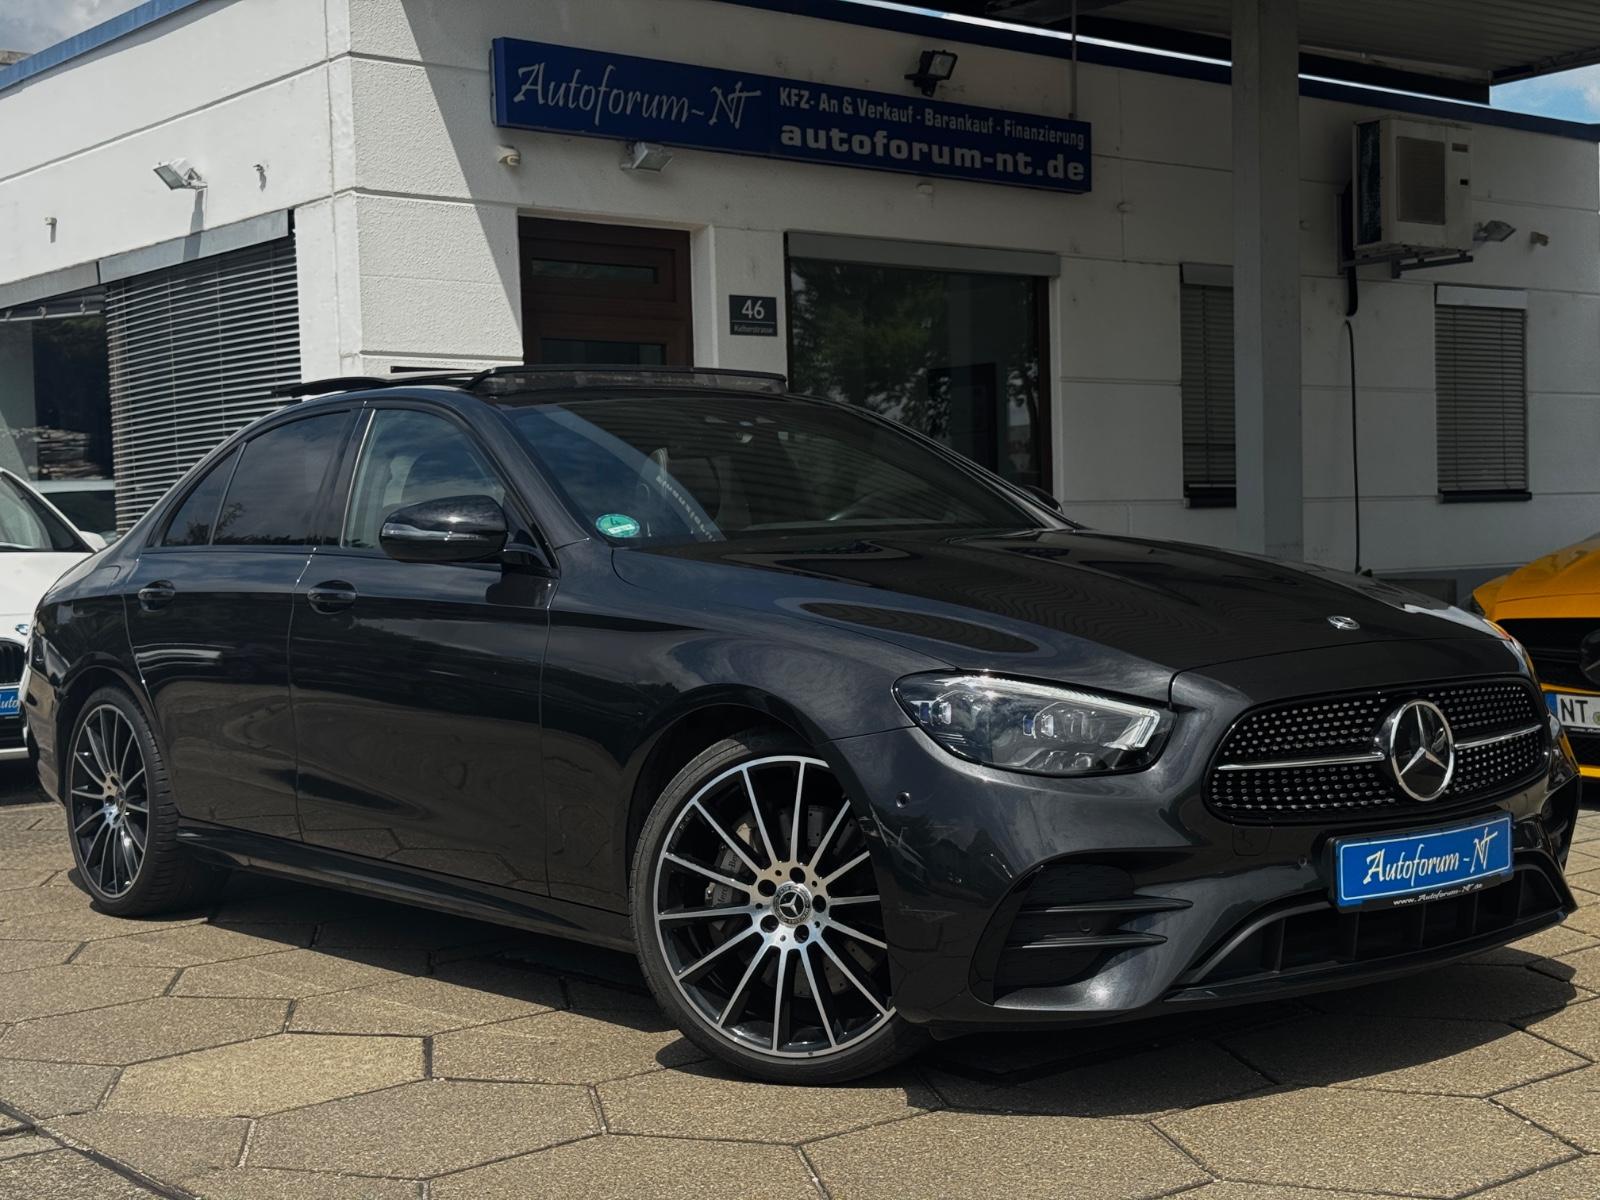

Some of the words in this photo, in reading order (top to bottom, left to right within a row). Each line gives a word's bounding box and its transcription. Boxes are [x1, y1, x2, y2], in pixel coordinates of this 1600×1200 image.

[513, 62, 761, 129] Autoforum-NT
[779, 86, 815, 109] KFZ-
[819, 93, 839, 113] An
[842, 97, 854, 115] &
[857, 99, 913, 124] Verkauf
[924, 108, 994, 133] Barankauf
[1004, 119, 1085, 150] Finanzierung
[780, 123, 1085, 181] autoforum-nt.de
[741, 299, 765, 319] 46
[1560, 698, 1588, 723] NT
